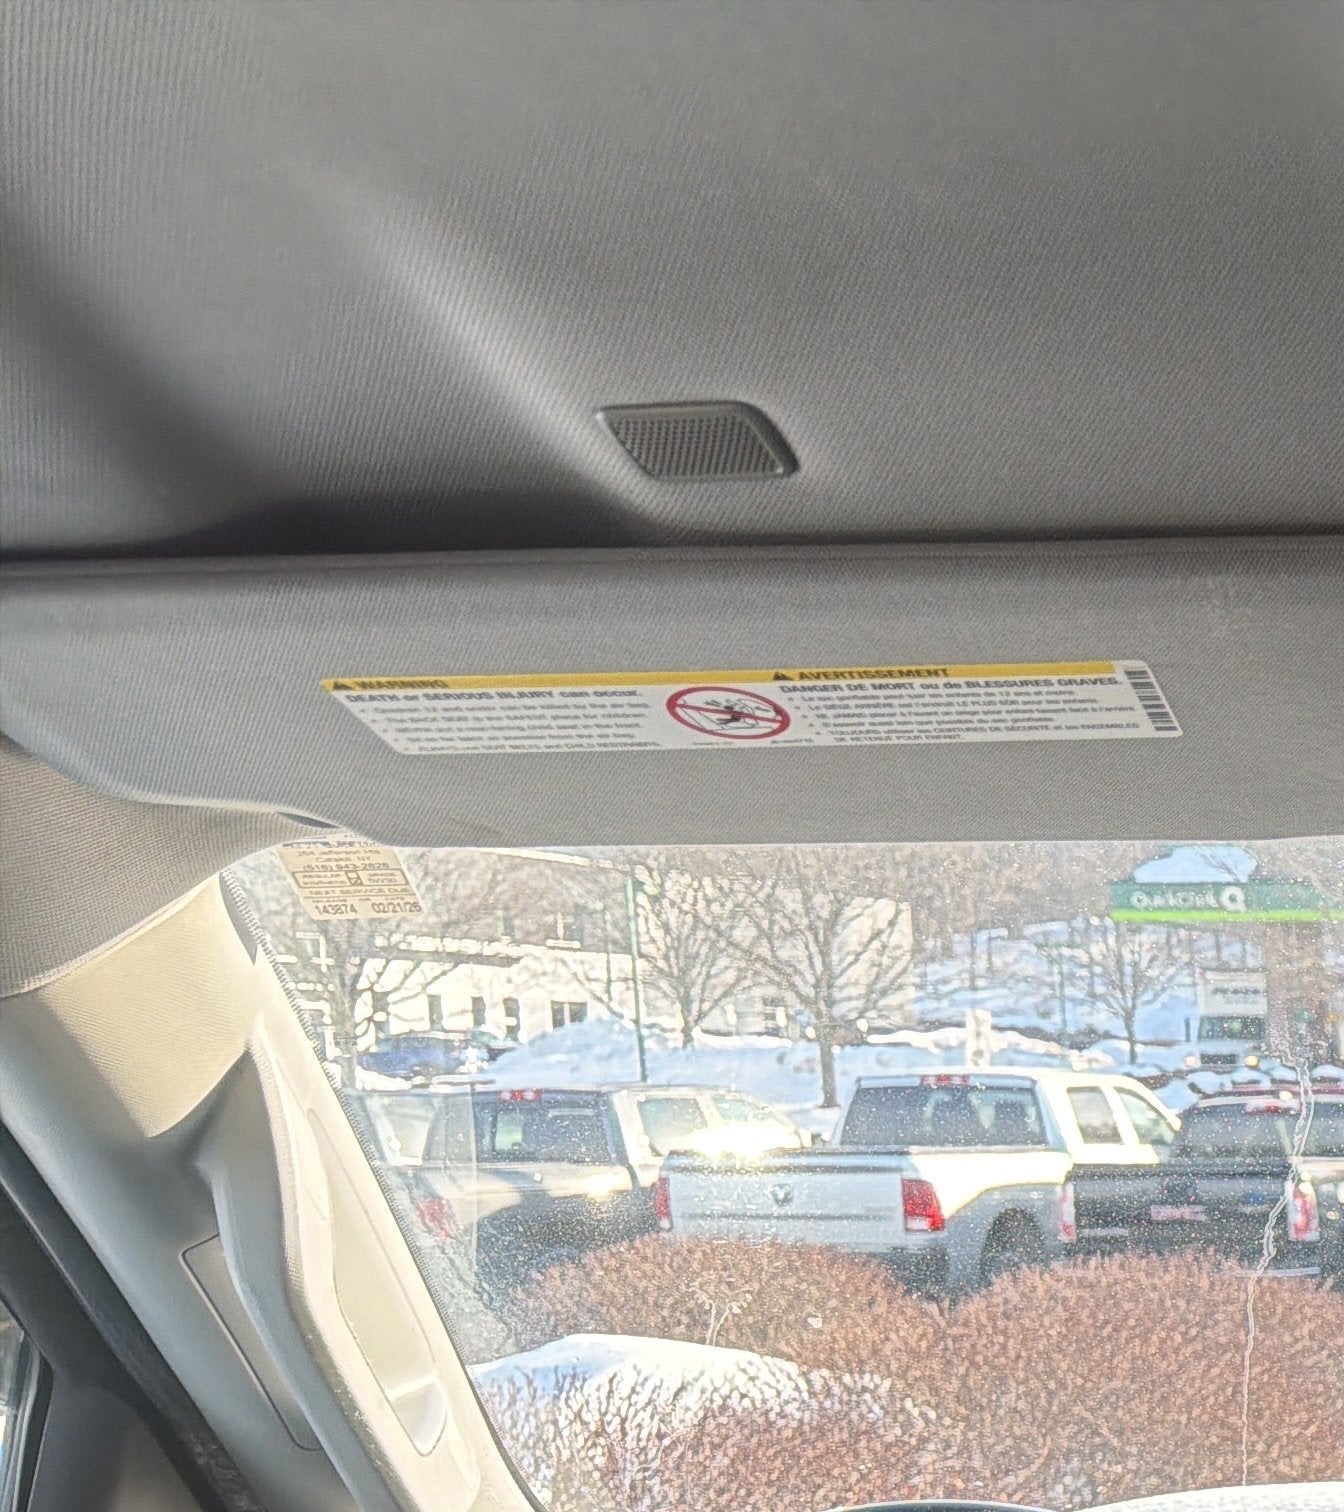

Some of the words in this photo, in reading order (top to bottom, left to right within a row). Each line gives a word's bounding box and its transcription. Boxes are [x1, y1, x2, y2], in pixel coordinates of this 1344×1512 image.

[799, 668, 950, 680] AVERTISSEMENT
[779, 683, 844, 694] DANGER
[846, 683, 869, 692] DE
[870, 682, 915, 691] MORT
[965, 678, 1055, 689] BLESSURES
